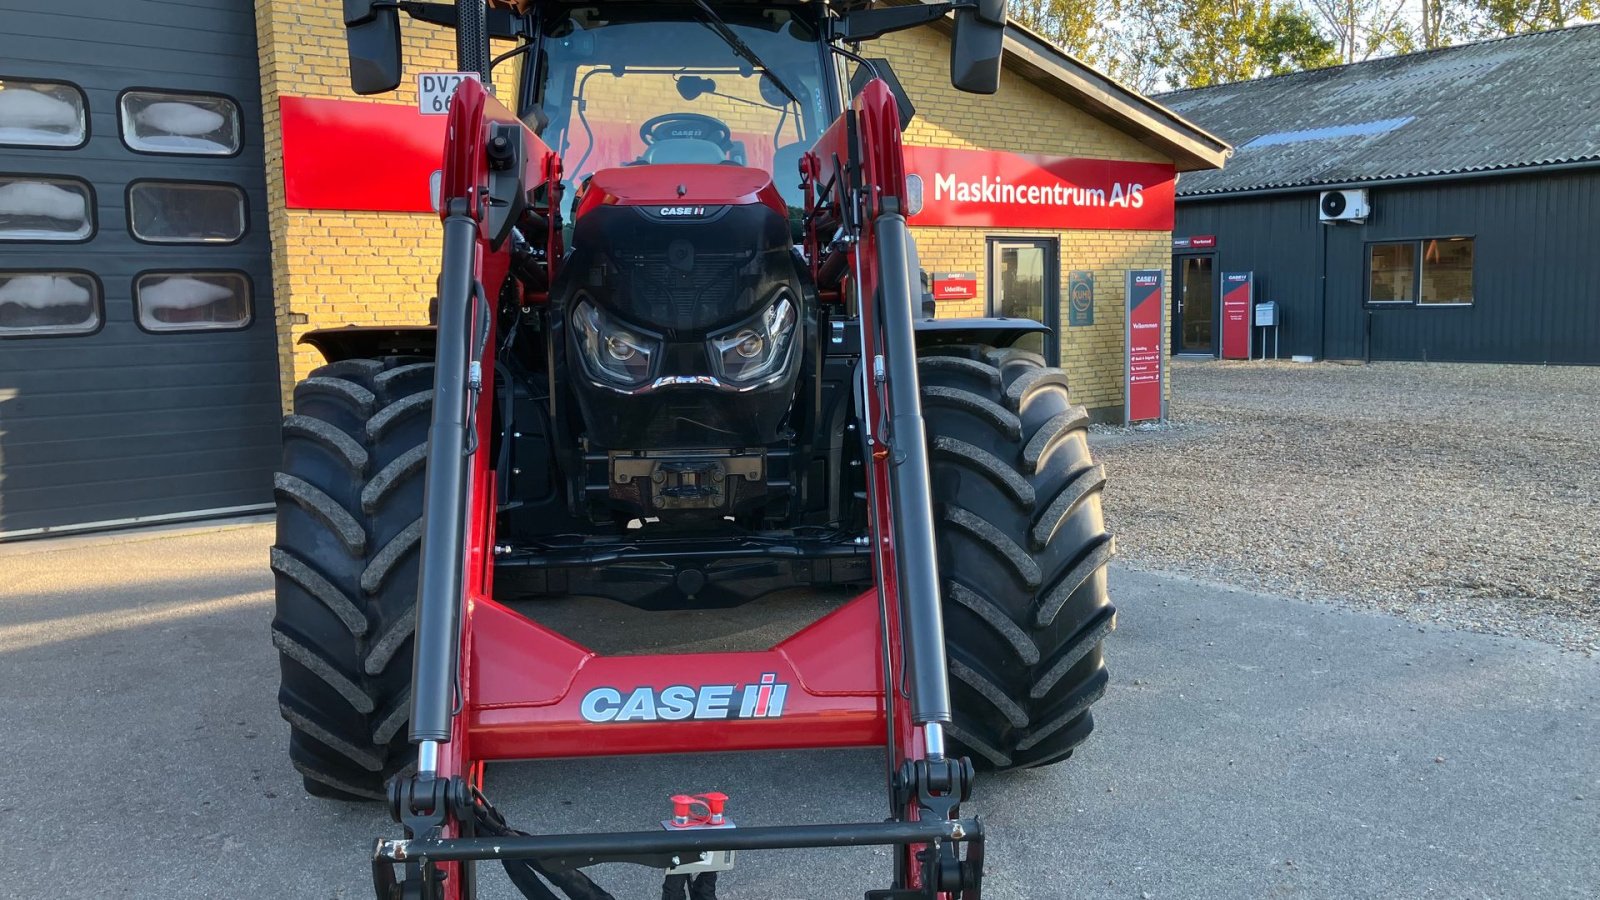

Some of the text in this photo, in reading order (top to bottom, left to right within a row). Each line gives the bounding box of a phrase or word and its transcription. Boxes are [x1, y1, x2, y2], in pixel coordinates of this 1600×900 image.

[934, 172, 1145, 208] Maskincentrum A/S
[660, 207, 692, 216] CASE
[580, 685, 733, 723] CASE
